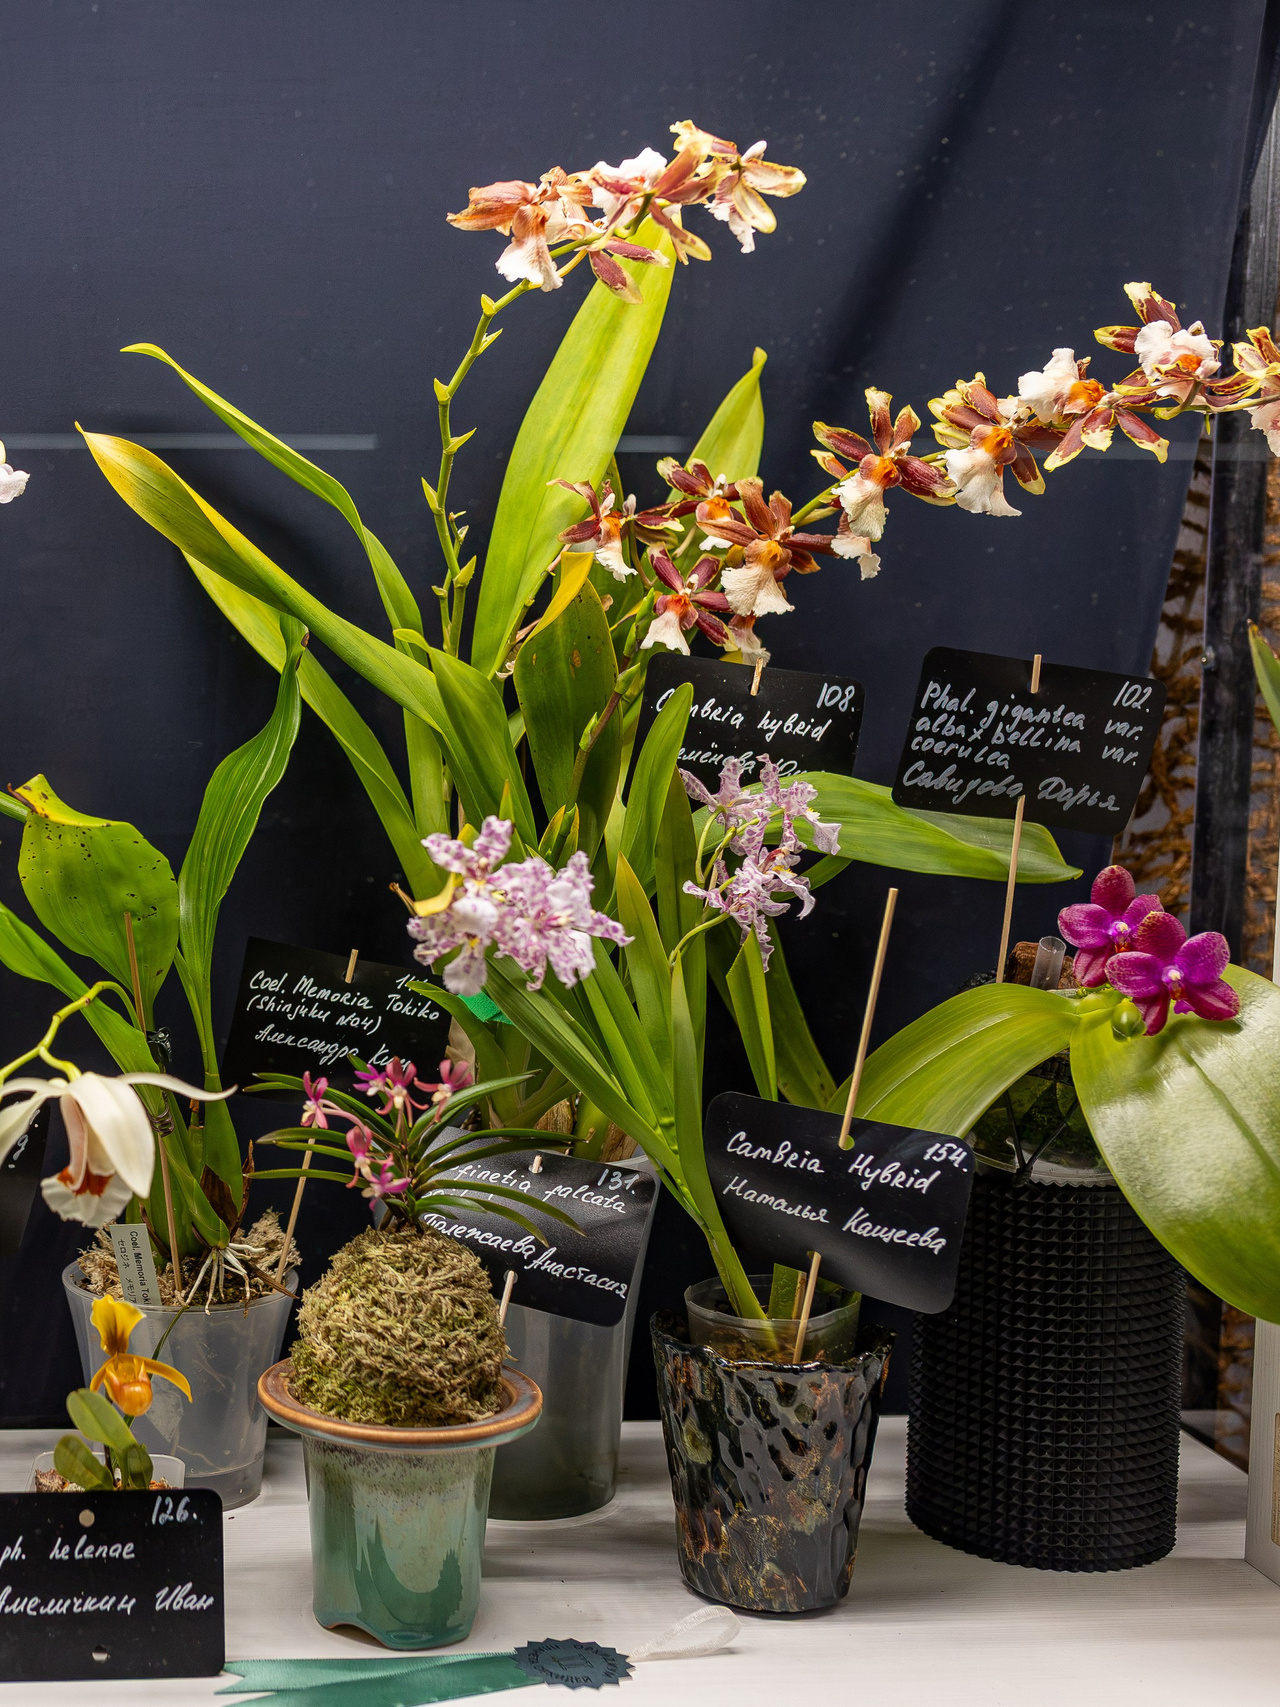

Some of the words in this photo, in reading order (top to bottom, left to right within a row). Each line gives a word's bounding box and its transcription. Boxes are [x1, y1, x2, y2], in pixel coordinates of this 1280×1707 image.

[816, 682, 856, 713] 108.
[920, 680, 977, 715] Phal.
[979, 694, 1086, 733] gigantea
[1104, 718, 1144, 741] var.
[1113, 681, 1153, 713] 102.
[757, 710, 833, 742] hybrid
[915, 713, 965, 738] alba
[991, 722, 1082, 753] bellina
[1101, 745, 1139, 766] var.
[911, 735, 1010, 769] coerulea
[1037, 776, 1121, 812] Дарья
[250, 970, 288, 993] Coel.
[292, 975, 373, 1010] Memoria
[386, 993, 440, 1020] Tokiko
[726, 1131, 825, 1174] Cambria
[847, 1153, 941, 1194] Hybrid
[923, 1142, 968, 1173] 154.
[542, 1184, 627, 1214] falcata
[722, 1175, 830, 1224] Наталья
[842, 1207, 947, 1255] Кащеева
[133, 1253, 147, 1287] Memoria
[524, 1246, 629, 1299] Анастасия
[151, 1496, 198, 1525] 126.
[49, 1534, 136, 1560] helenae
[155, 1582, 214, 1612] Иван
